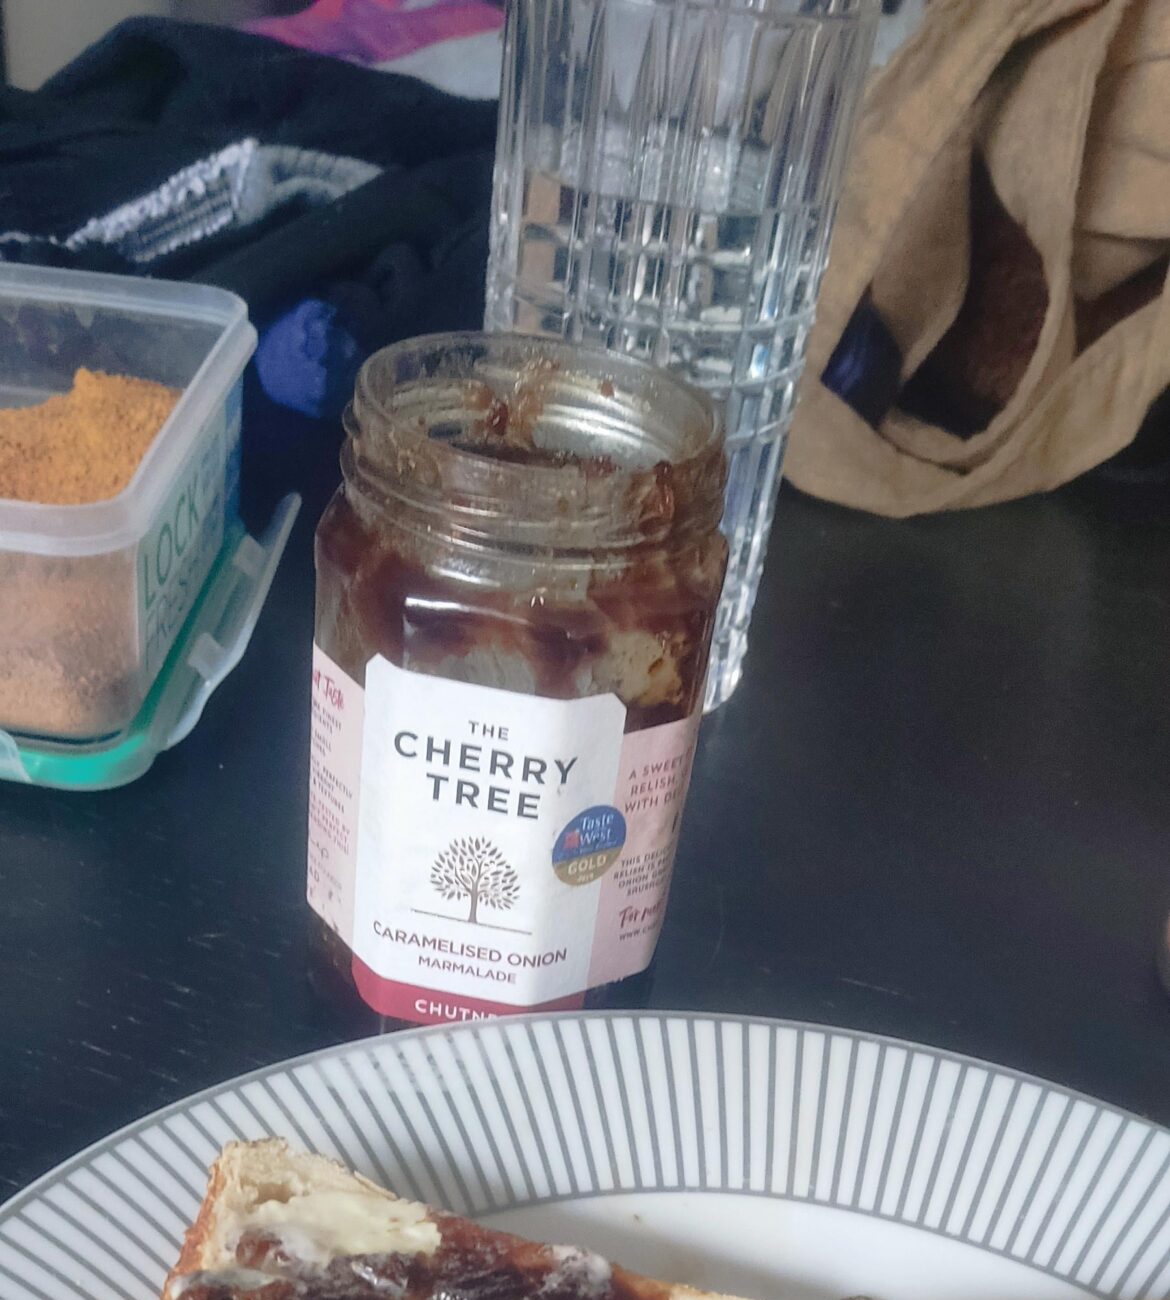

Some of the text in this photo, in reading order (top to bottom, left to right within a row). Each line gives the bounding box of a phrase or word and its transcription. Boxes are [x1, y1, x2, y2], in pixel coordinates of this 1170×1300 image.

[143, 473, 199, 611] LOCK
[468, 719, 510, 742] THE
[393, 730, 579, 786] CHERRY
[628, 769, 637, 781] A
[426, 771, 542, 820] TREE
[567, 853, 607, 876] GOLD
[372, 920, 568, 969] CARAMELISED ONION
[417, 955, 517, 985] MARMALADE
